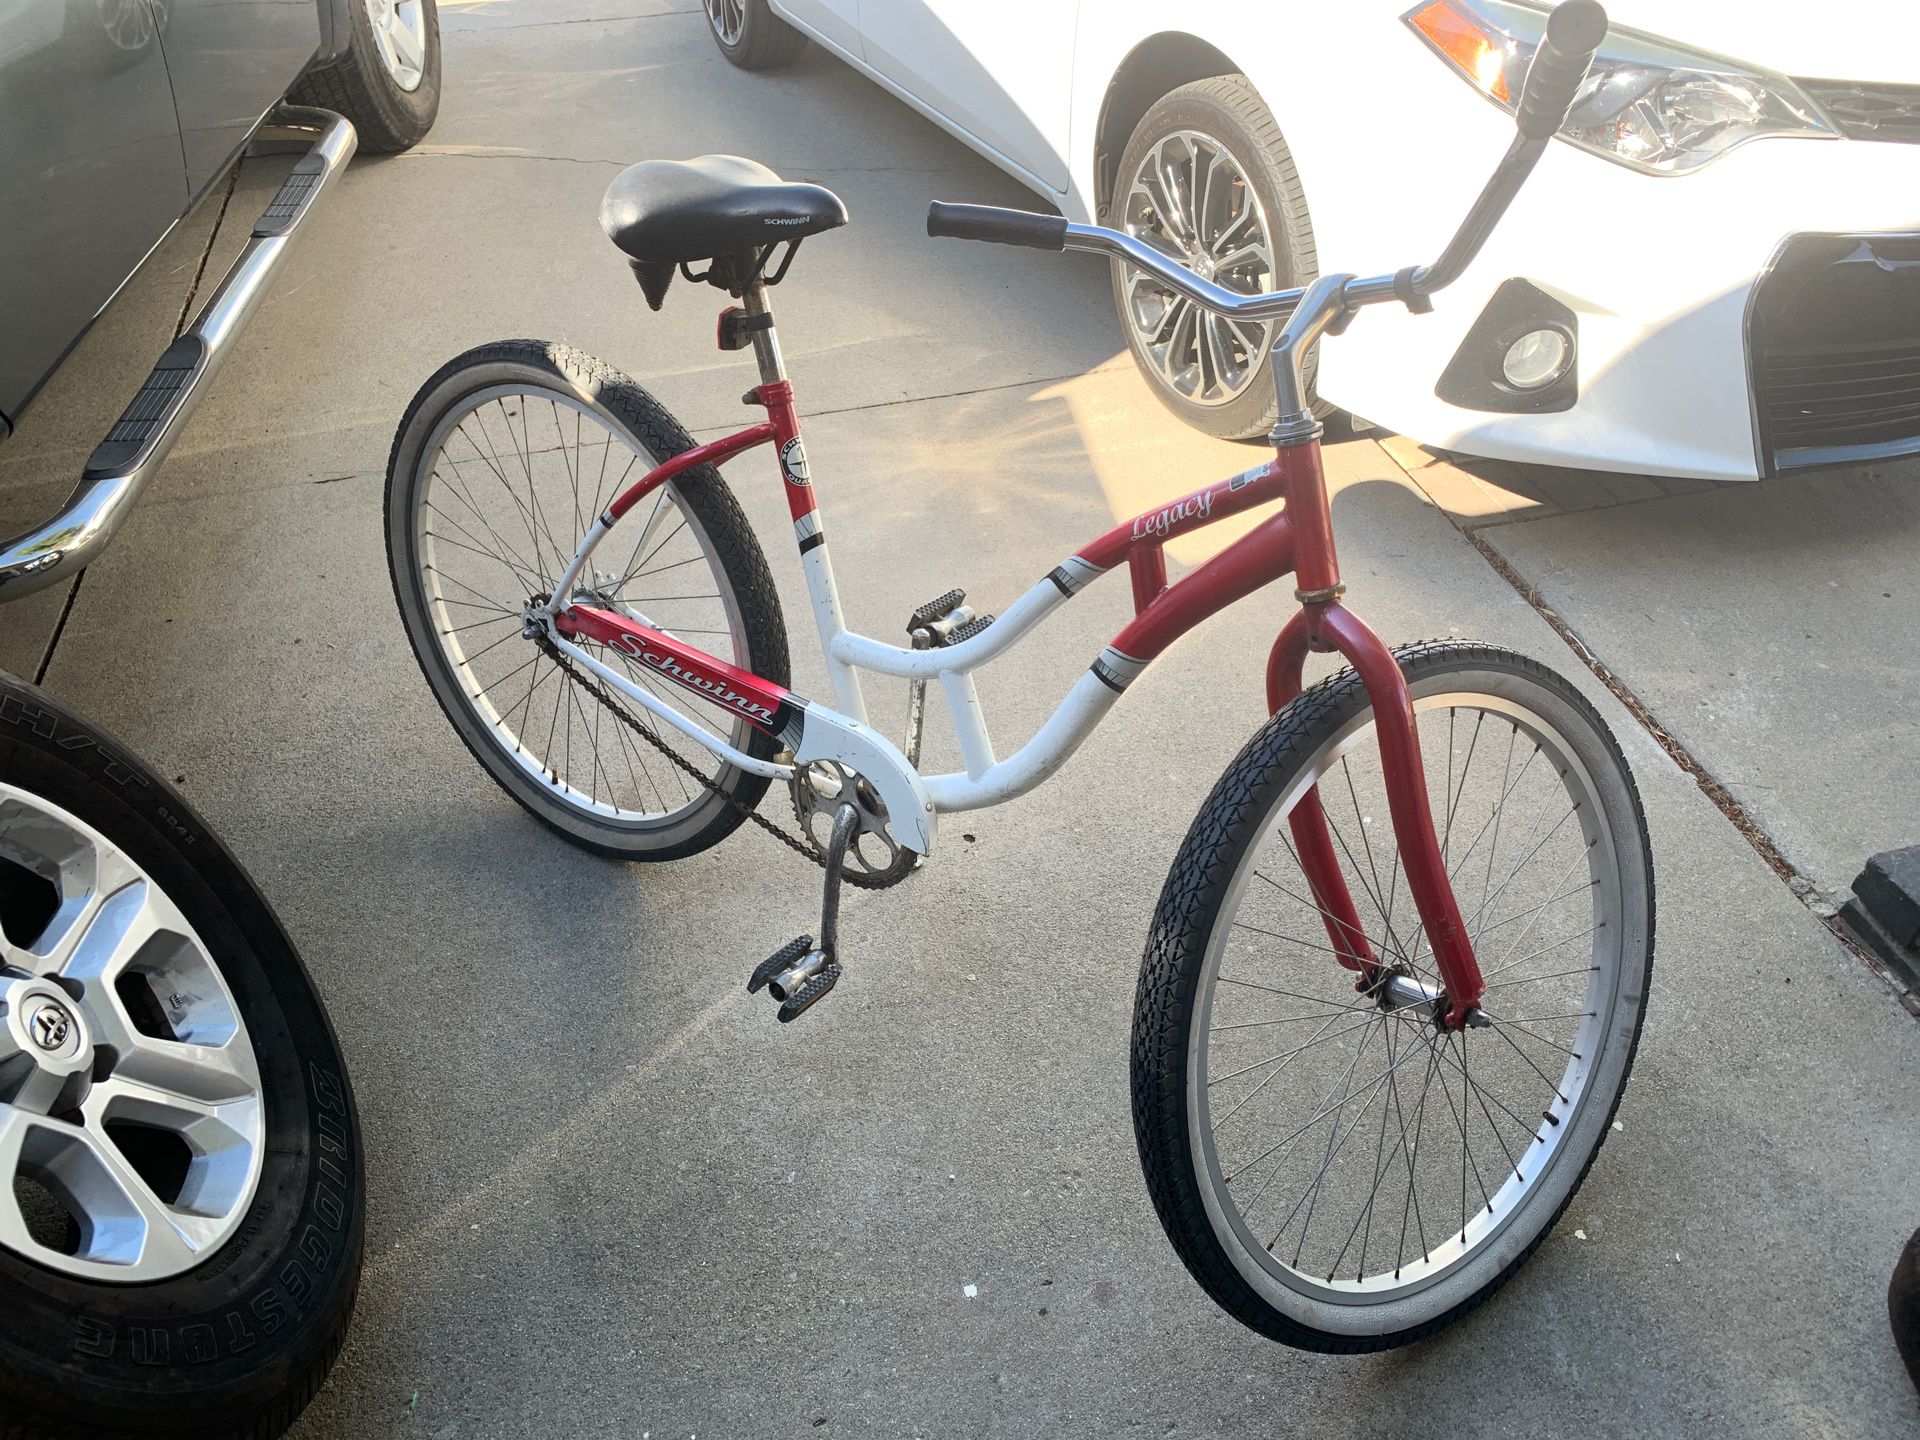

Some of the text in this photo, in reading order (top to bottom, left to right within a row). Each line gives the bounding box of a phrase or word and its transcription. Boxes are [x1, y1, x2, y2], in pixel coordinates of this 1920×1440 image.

[764, 216, 810, 225] SCHWINN
[1131, 490, 1216, 541] Legacy
[608, 633, 773, 725] Schwinn
[72, 1060, 347, 1366] BRIDGESTONE
